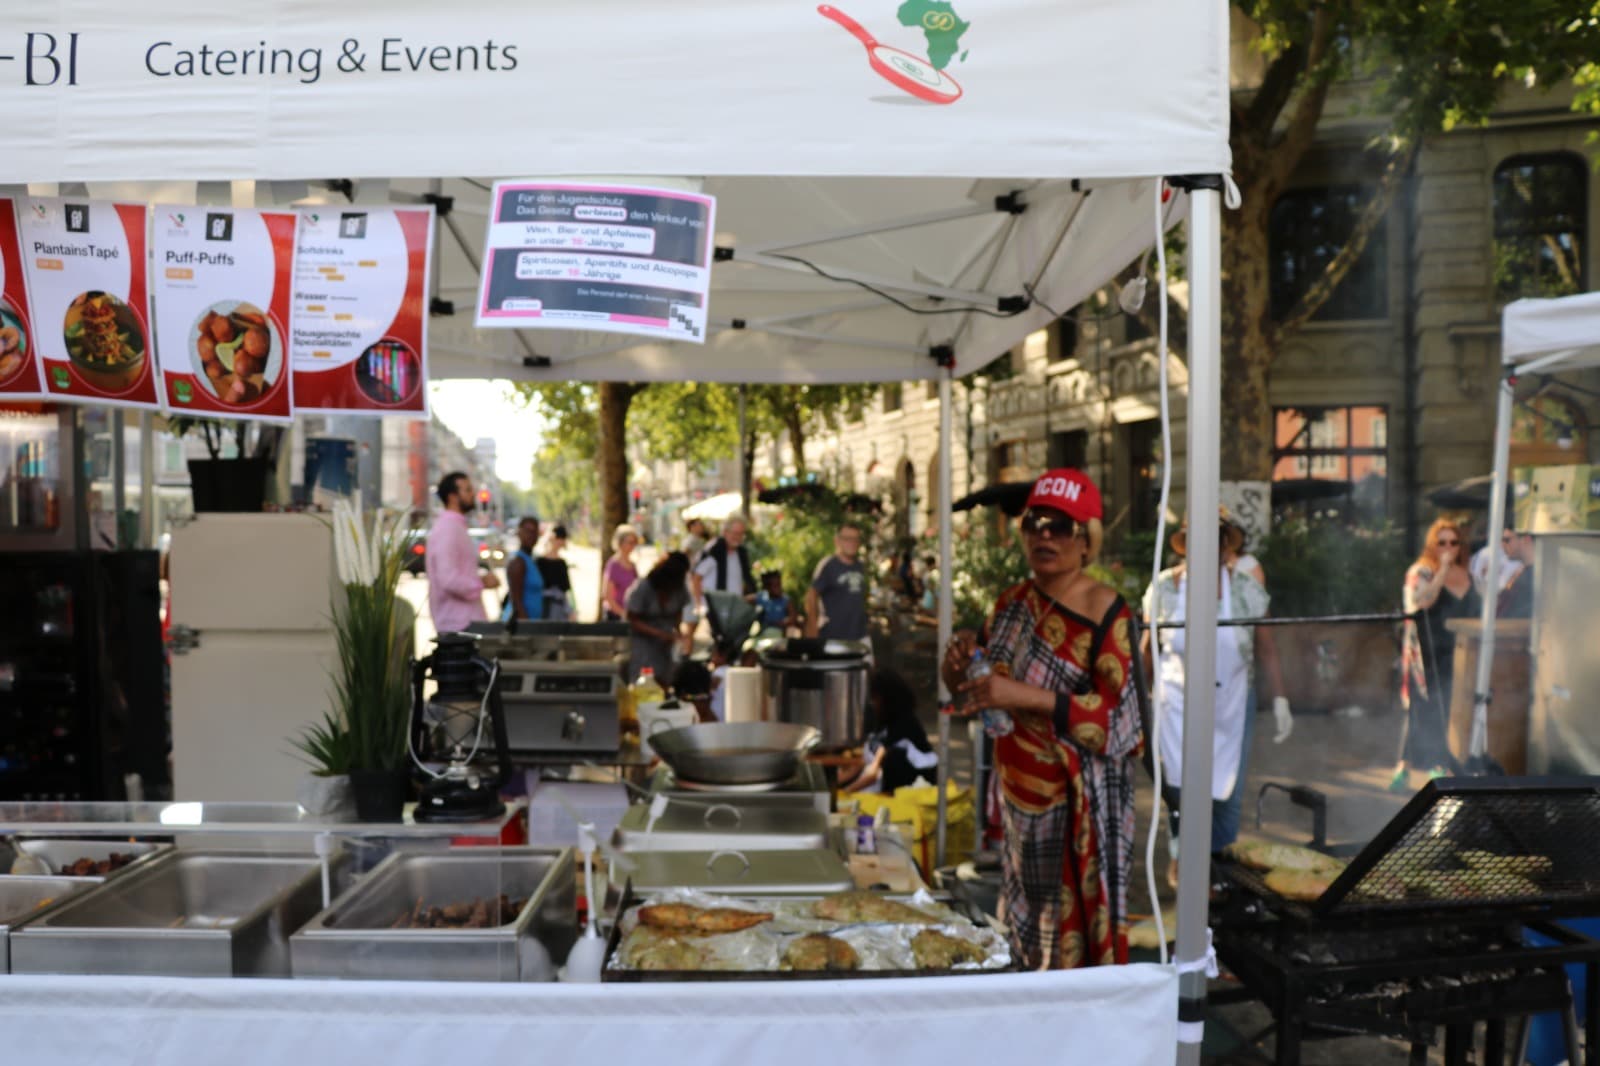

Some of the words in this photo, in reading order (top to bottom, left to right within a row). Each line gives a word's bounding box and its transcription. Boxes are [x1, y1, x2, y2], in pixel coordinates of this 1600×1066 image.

[145, 40, 323, 84] Catering
[336, 37, 367, 73] &
[381, 37, 519, 72] Events
[536, 194, 555, 203] den
[516, 206, 536, 216] Das
[538, 206, 571, 216] Gesetz
[577, 208, 625, 218] verbietet
[630, 211, 649, 220] den
[651, 212, 688, 225] Verkauf
[557, 226, 578, 235] Bier
[581, 227, 600, 236] und
[603, 227, 652, 240] Apfelwein
[540, 238, 566, 246] unter
[297, 245, 345, 256] Softdrinks
[166, 250, 235, 266] Puff-Puffs
[520, 268, 532, 276] an
[535, 268, 563, 276] unter
[585, 257, 628, 270] Aperitifs
[630, 261, 650, 271] und
[653, 263, 698, 279] Alcopops
[294, 291, 328, 301] Wasser
[293, 329, 362, 339] Hausgemachte
[293, 338, 353, 347] Spezialitäten
[1034, 477, 1082, 502] ICON
